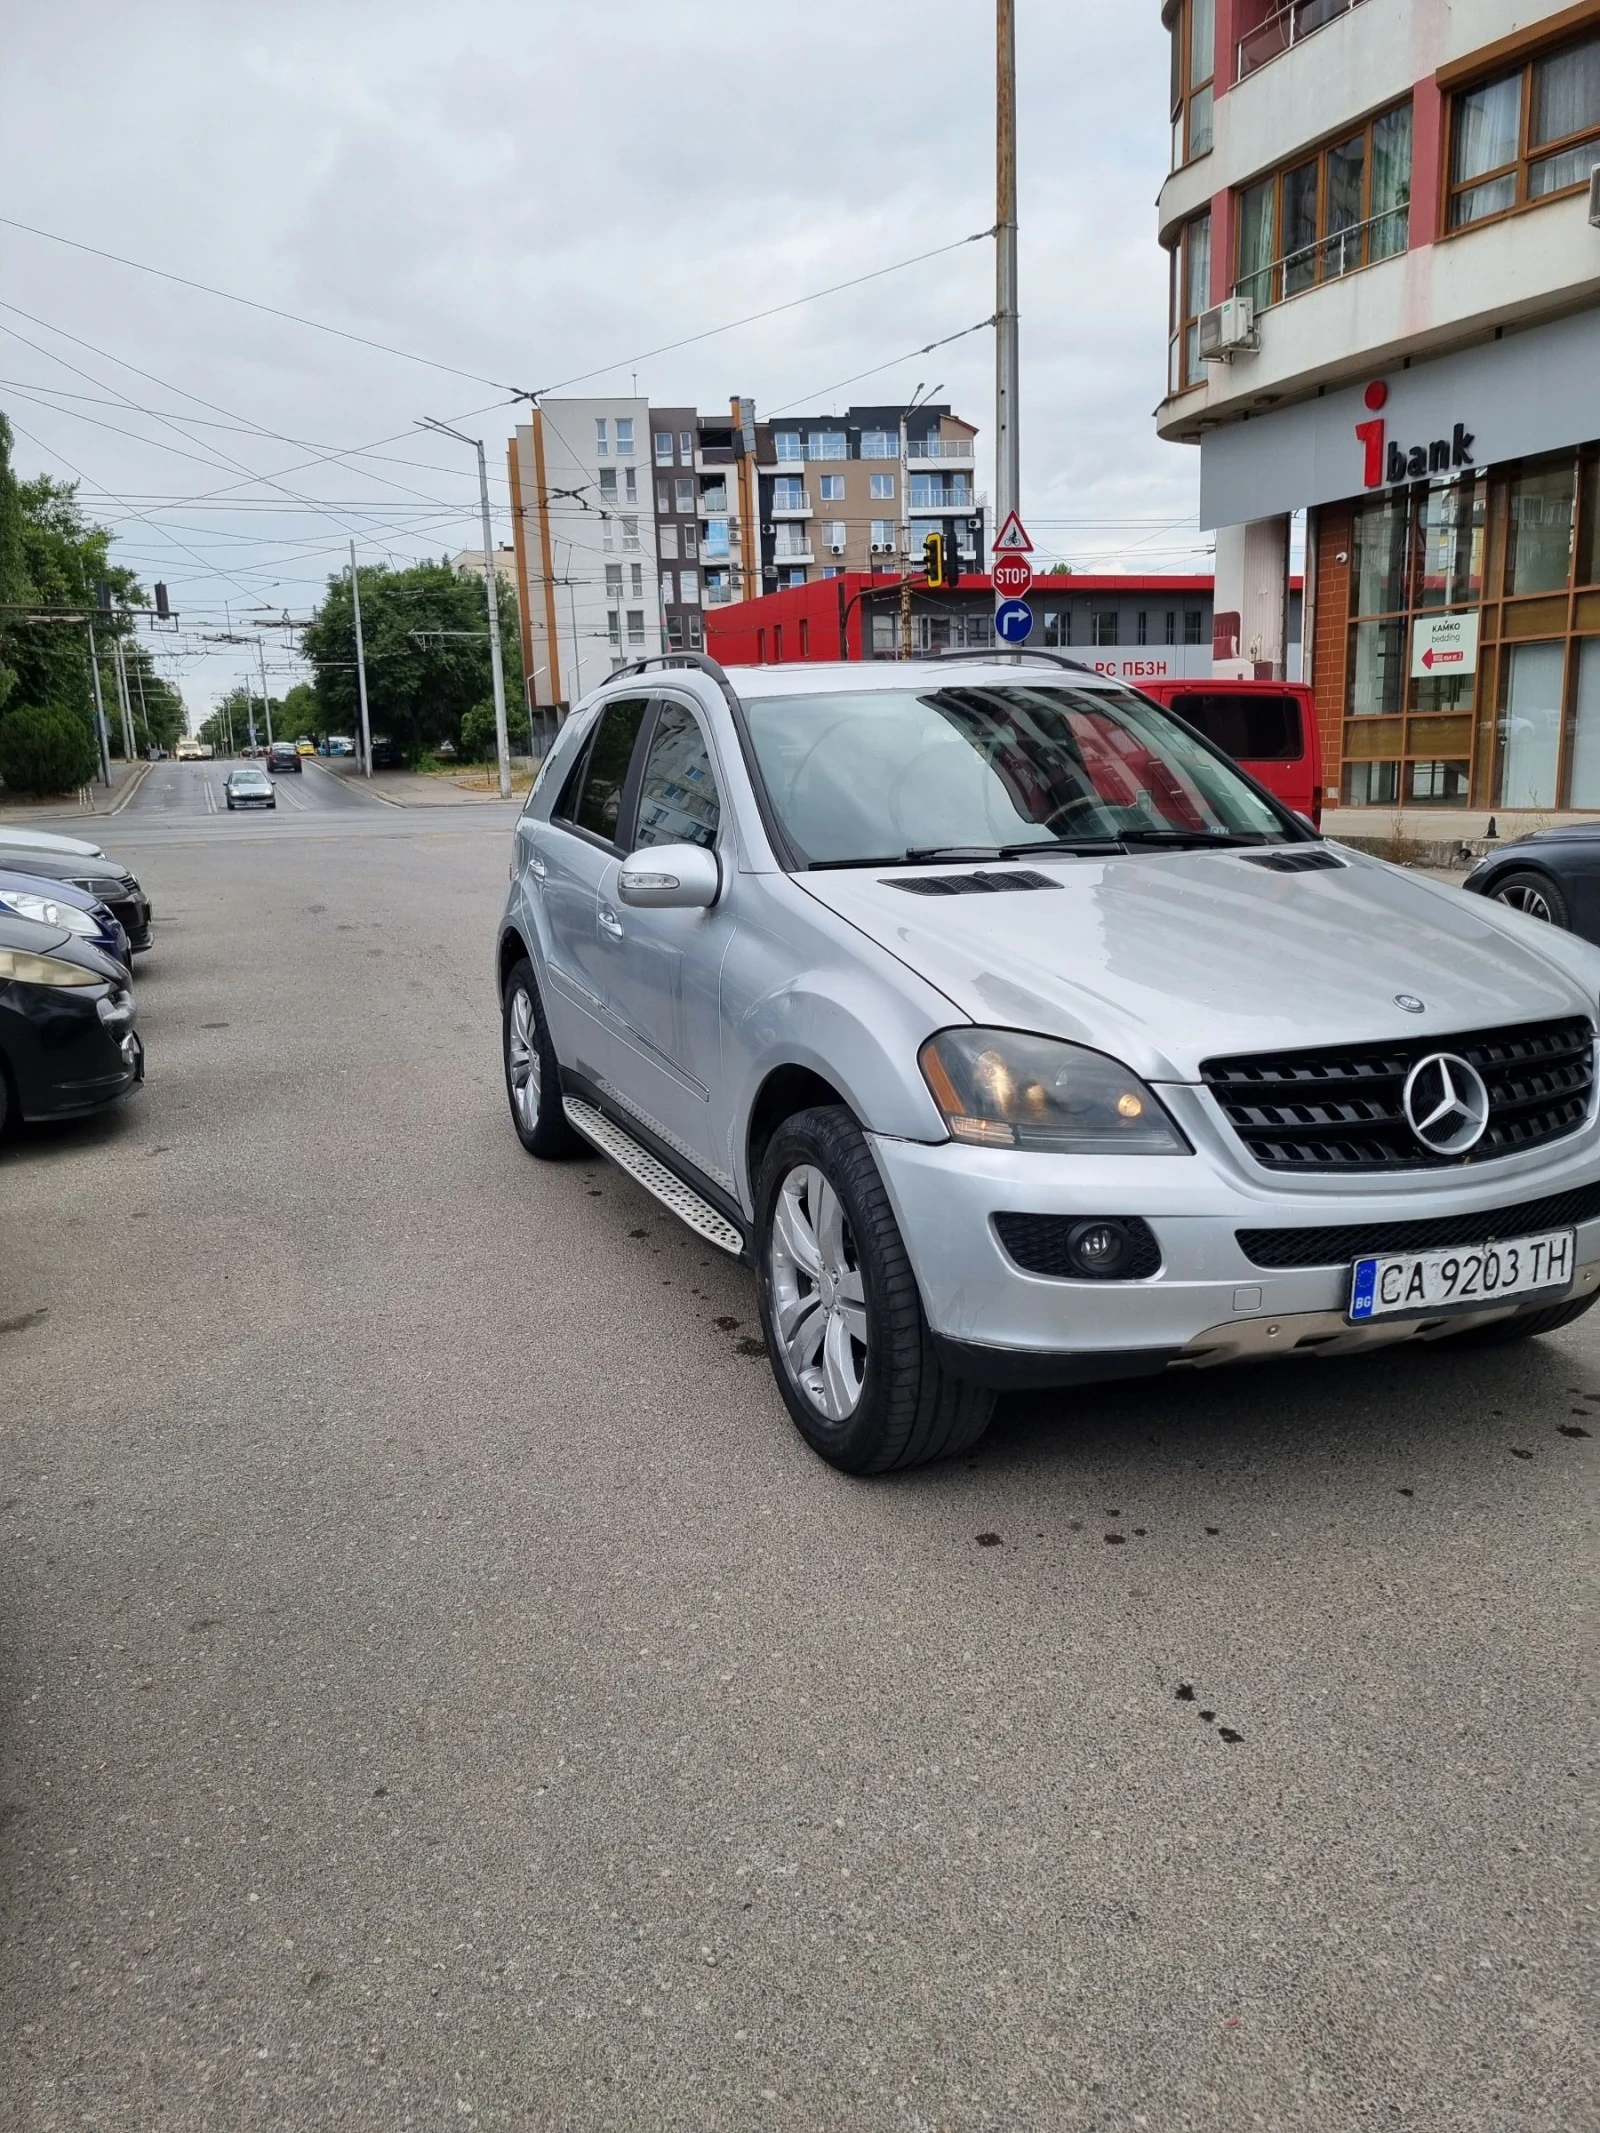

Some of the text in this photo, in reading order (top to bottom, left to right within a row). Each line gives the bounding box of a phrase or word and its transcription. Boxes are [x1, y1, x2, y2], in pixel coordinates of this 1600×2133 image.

[996, 567, 1028, 584] STOP
[1432, 634, 1461, 643] bedding
[1122, 661, 1167, 676] ПБЗН
[1380, 1237, 1568, 1304] CA 9203 TH
[1355, 1295, 1371, 1310] BG
